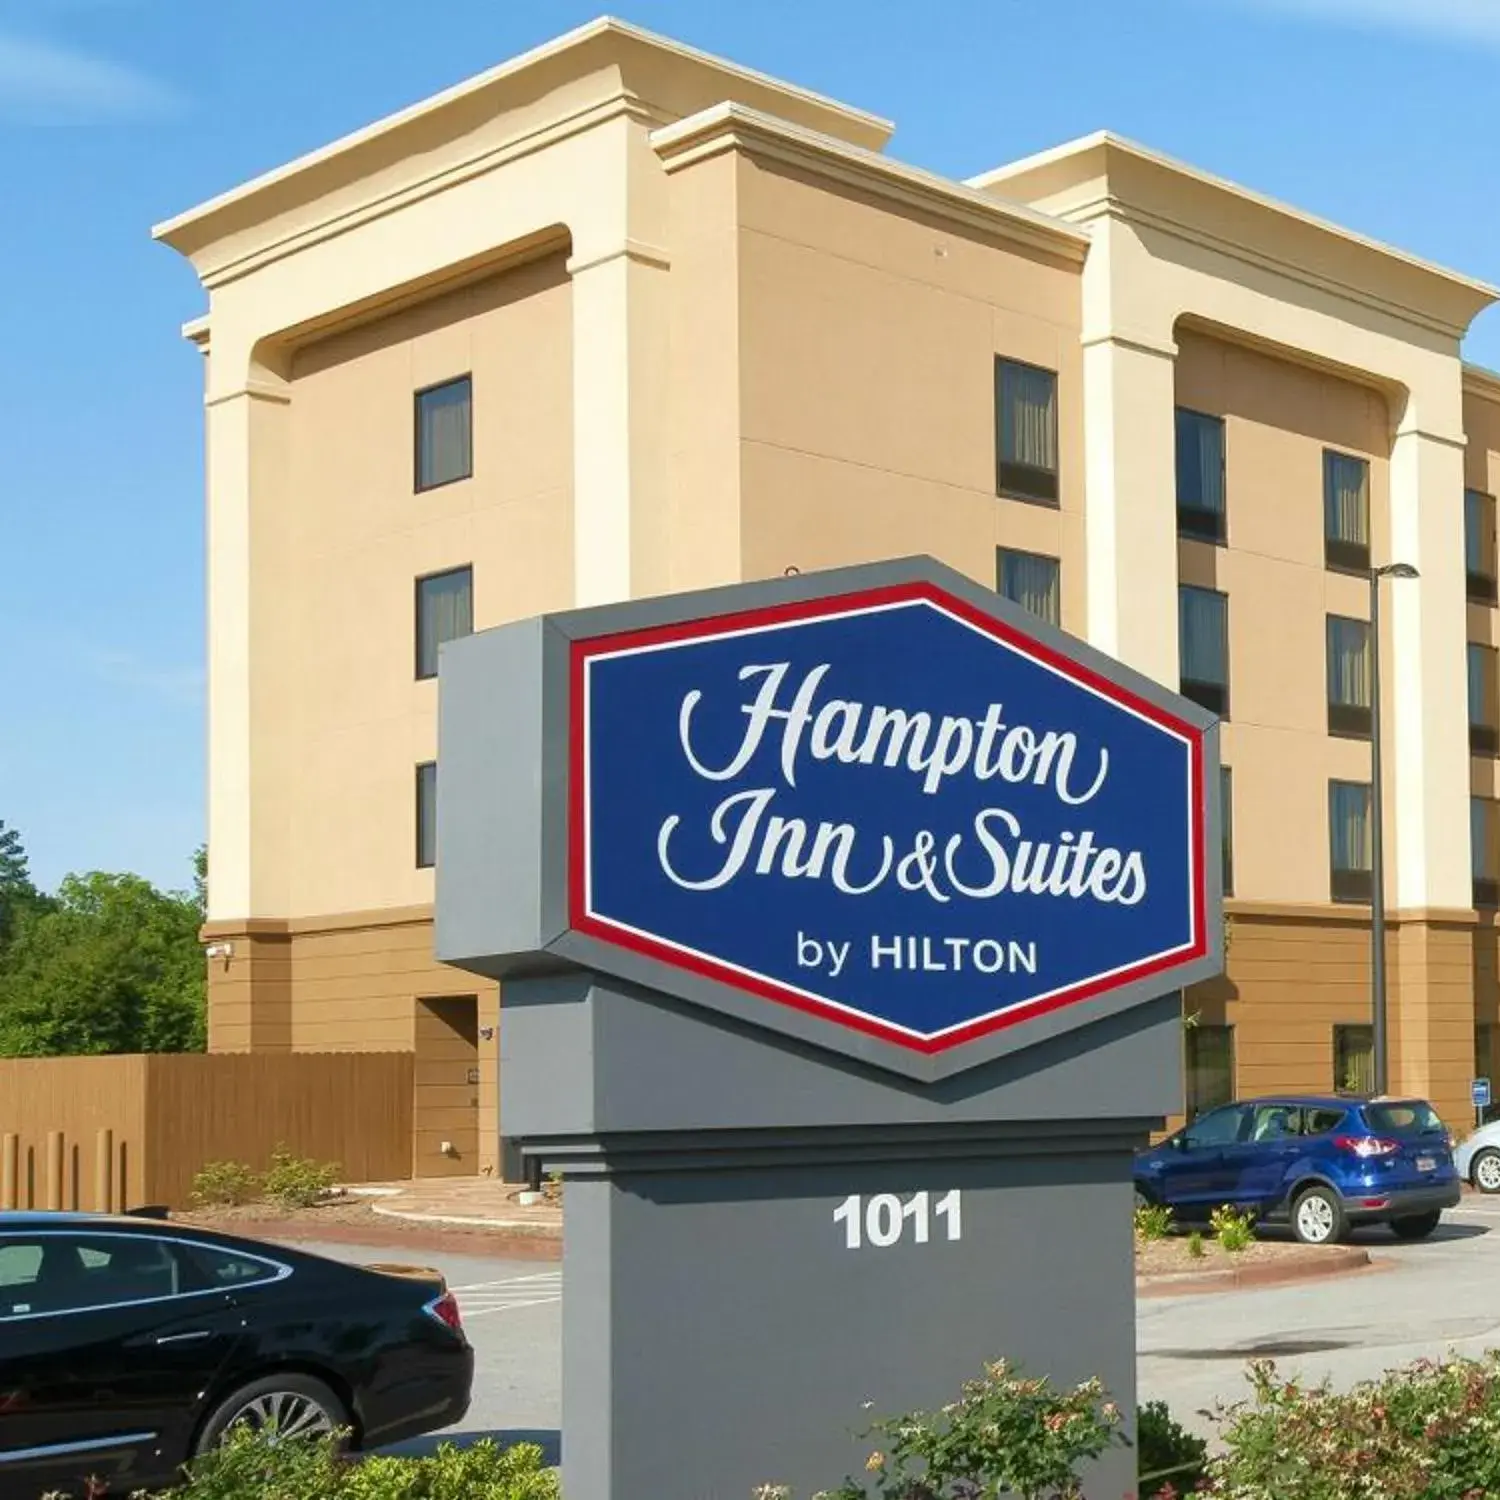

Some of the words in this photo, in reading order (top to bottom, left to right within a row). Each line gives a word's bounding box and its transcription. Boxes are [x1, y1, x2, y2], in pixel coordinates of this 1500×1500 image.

[680, 662, 1109, 804] Hampton
[658, 788, 894, 895] Inn
[897, 830, 951, 902] &
[945, 808, 1147, 906] Suites
[797, 932, 850, 977] by
[871, 936, 1037, 974] HILTON
[833, 1189, 961, 1249] 1011
